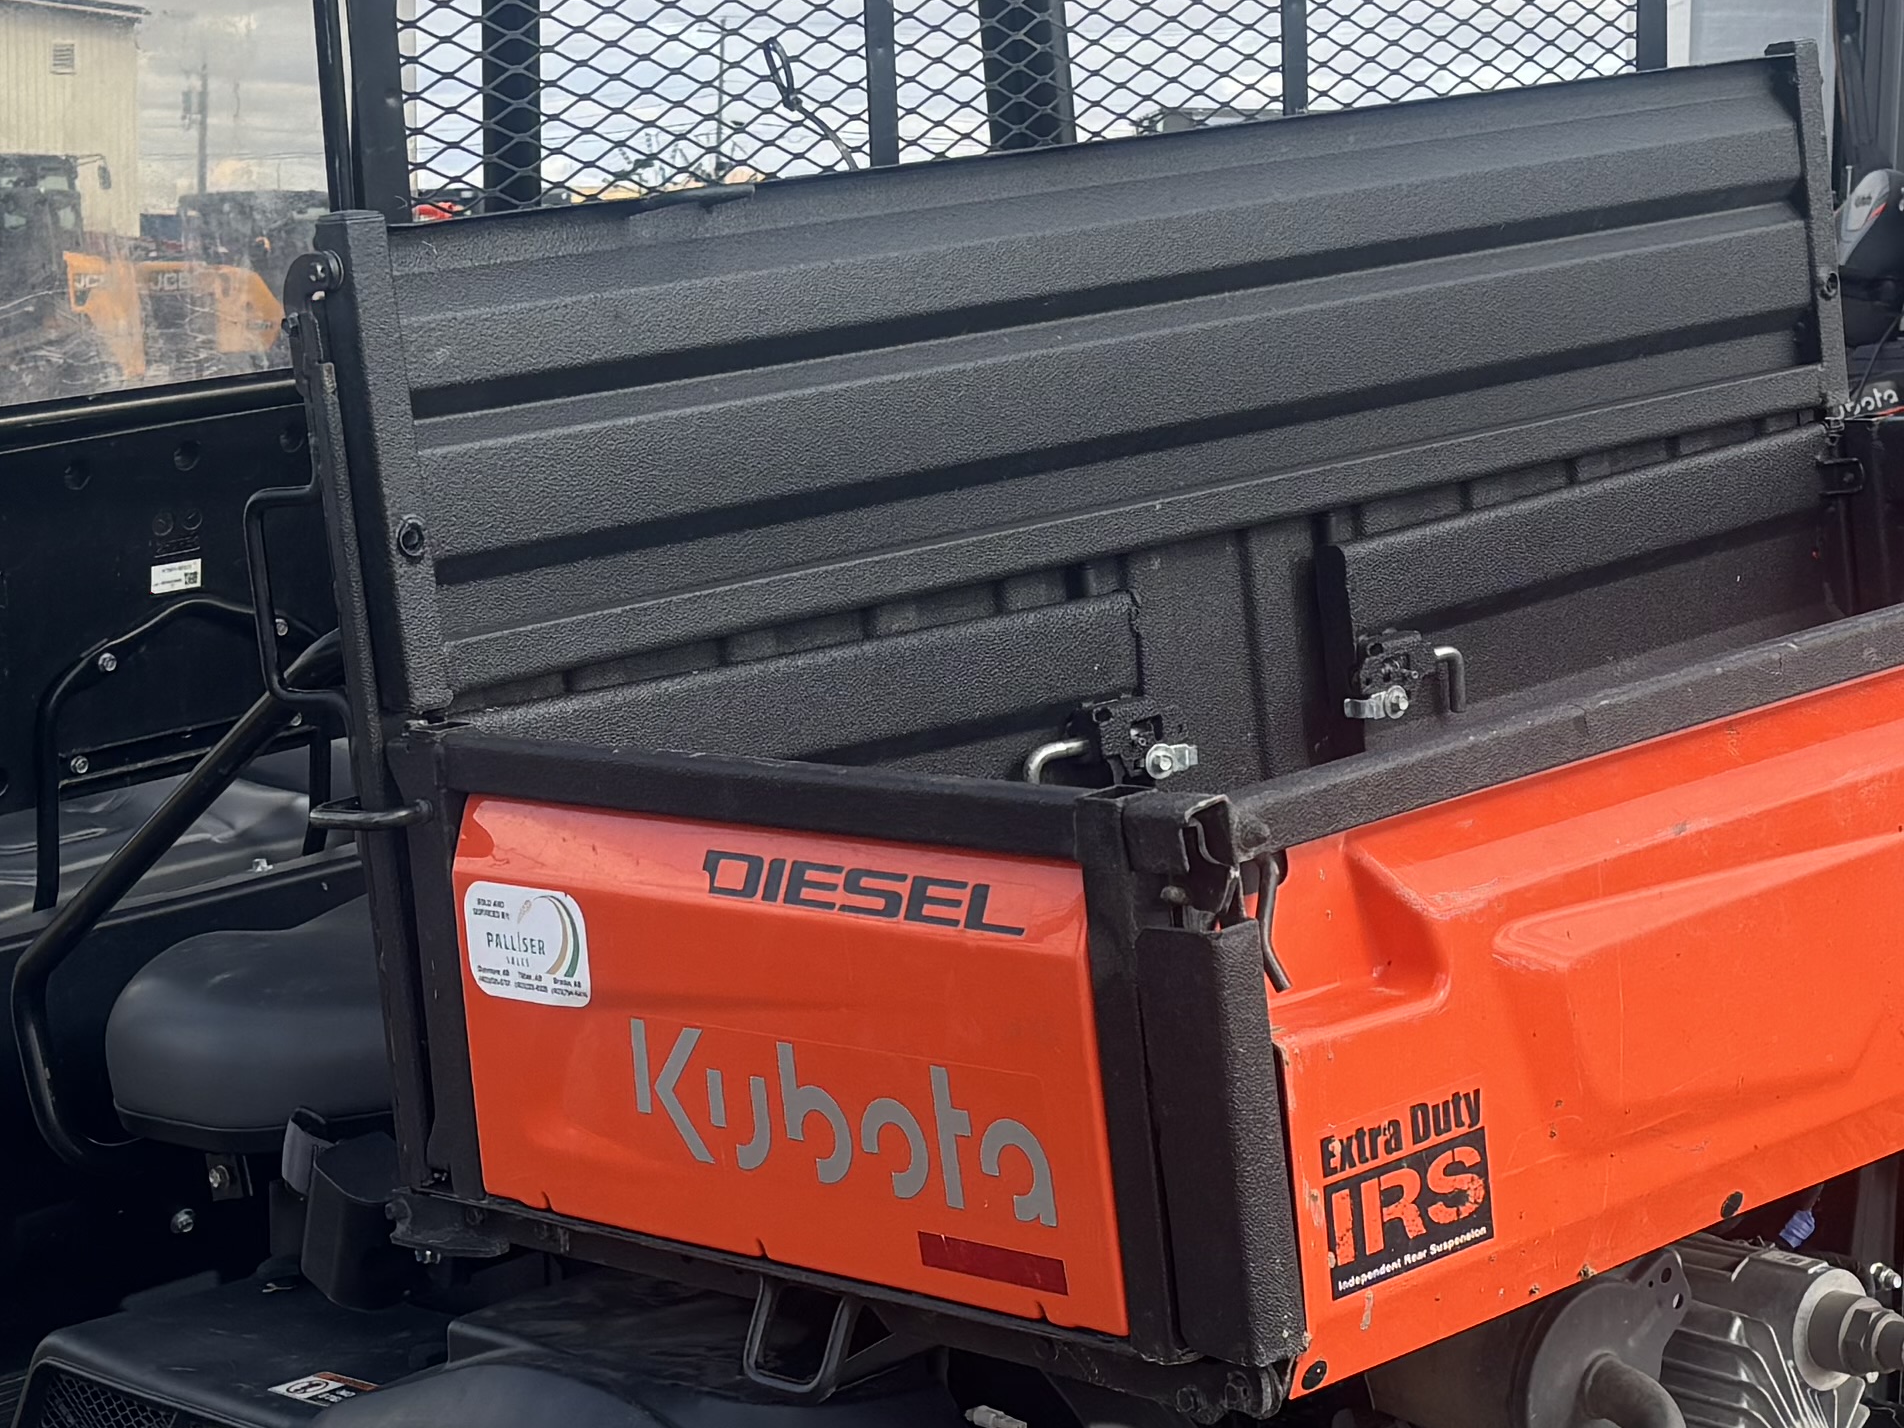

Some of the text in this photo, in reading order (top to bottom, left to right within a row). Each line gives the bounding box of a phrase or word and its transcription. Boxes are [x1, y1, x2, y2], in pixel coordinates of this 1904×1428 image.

[702, 849, 1025, 937] DIESEL
[486, 931, 546, 955] PALLISER
[628, 1016, 1059, 1228] Kubota
[1319, 1088, 1481, 1179] Extra Duty
[1331, 1146, 1486, 1266] IRS
[1338, 1225, 1487, 1291] Independent Rear Suspension
